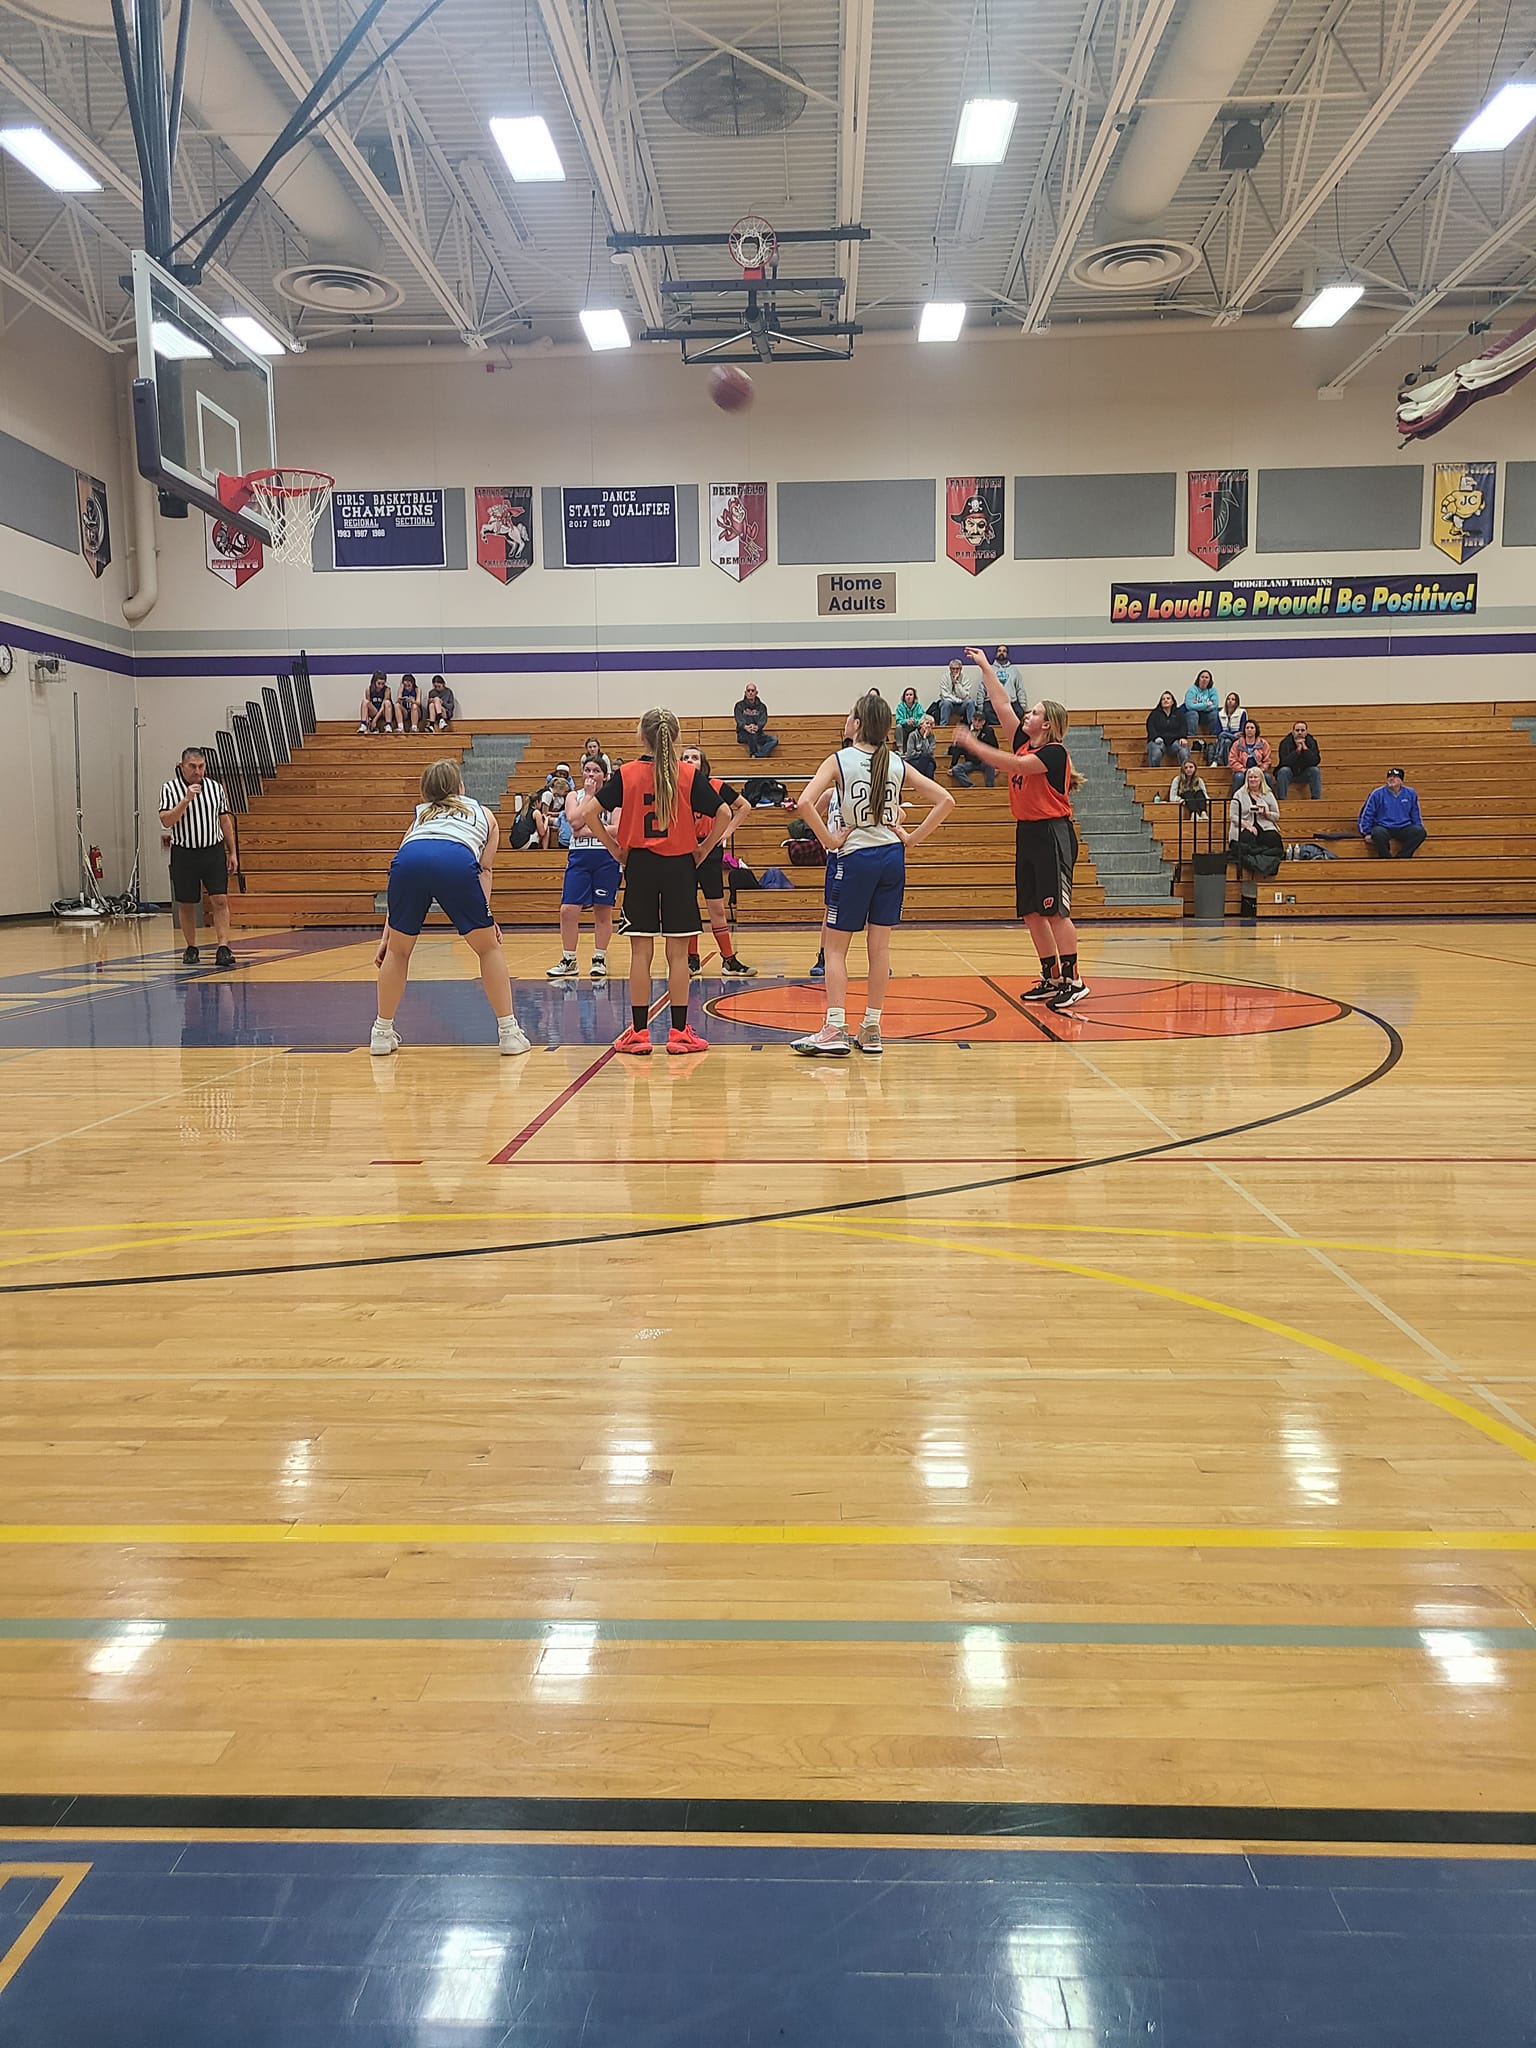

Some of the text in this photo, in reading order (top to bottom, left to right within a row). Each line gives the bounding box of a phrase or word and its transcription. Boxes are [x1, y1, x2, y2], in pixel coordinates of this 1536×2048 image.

[602, 490, 637, 502] DANCE
[712, 485, 766, 496] DEERFIELD
[336, 491, 438, 506] GIRLS BASKETBALL
[1460, 495, 1478, 505] JC
[341, 504, 433, 518] CHAMPIONS
[568, 503, 671, 518] STATE QUALIFIER
[343, 516, 435, 528] REGIONAL SECTIONAL
[568, 520, 588, 528] 2017
[719, 556, 760, 565] DEMONS
[830, 576, 882, 591] Home
[1233, 578, 1333, 589] DODGELAND TROJANS
[829, 596, 886, 611] Adults
[1112, 583, 1475, 619] Be Loud! Be Proud! Be Positive!
